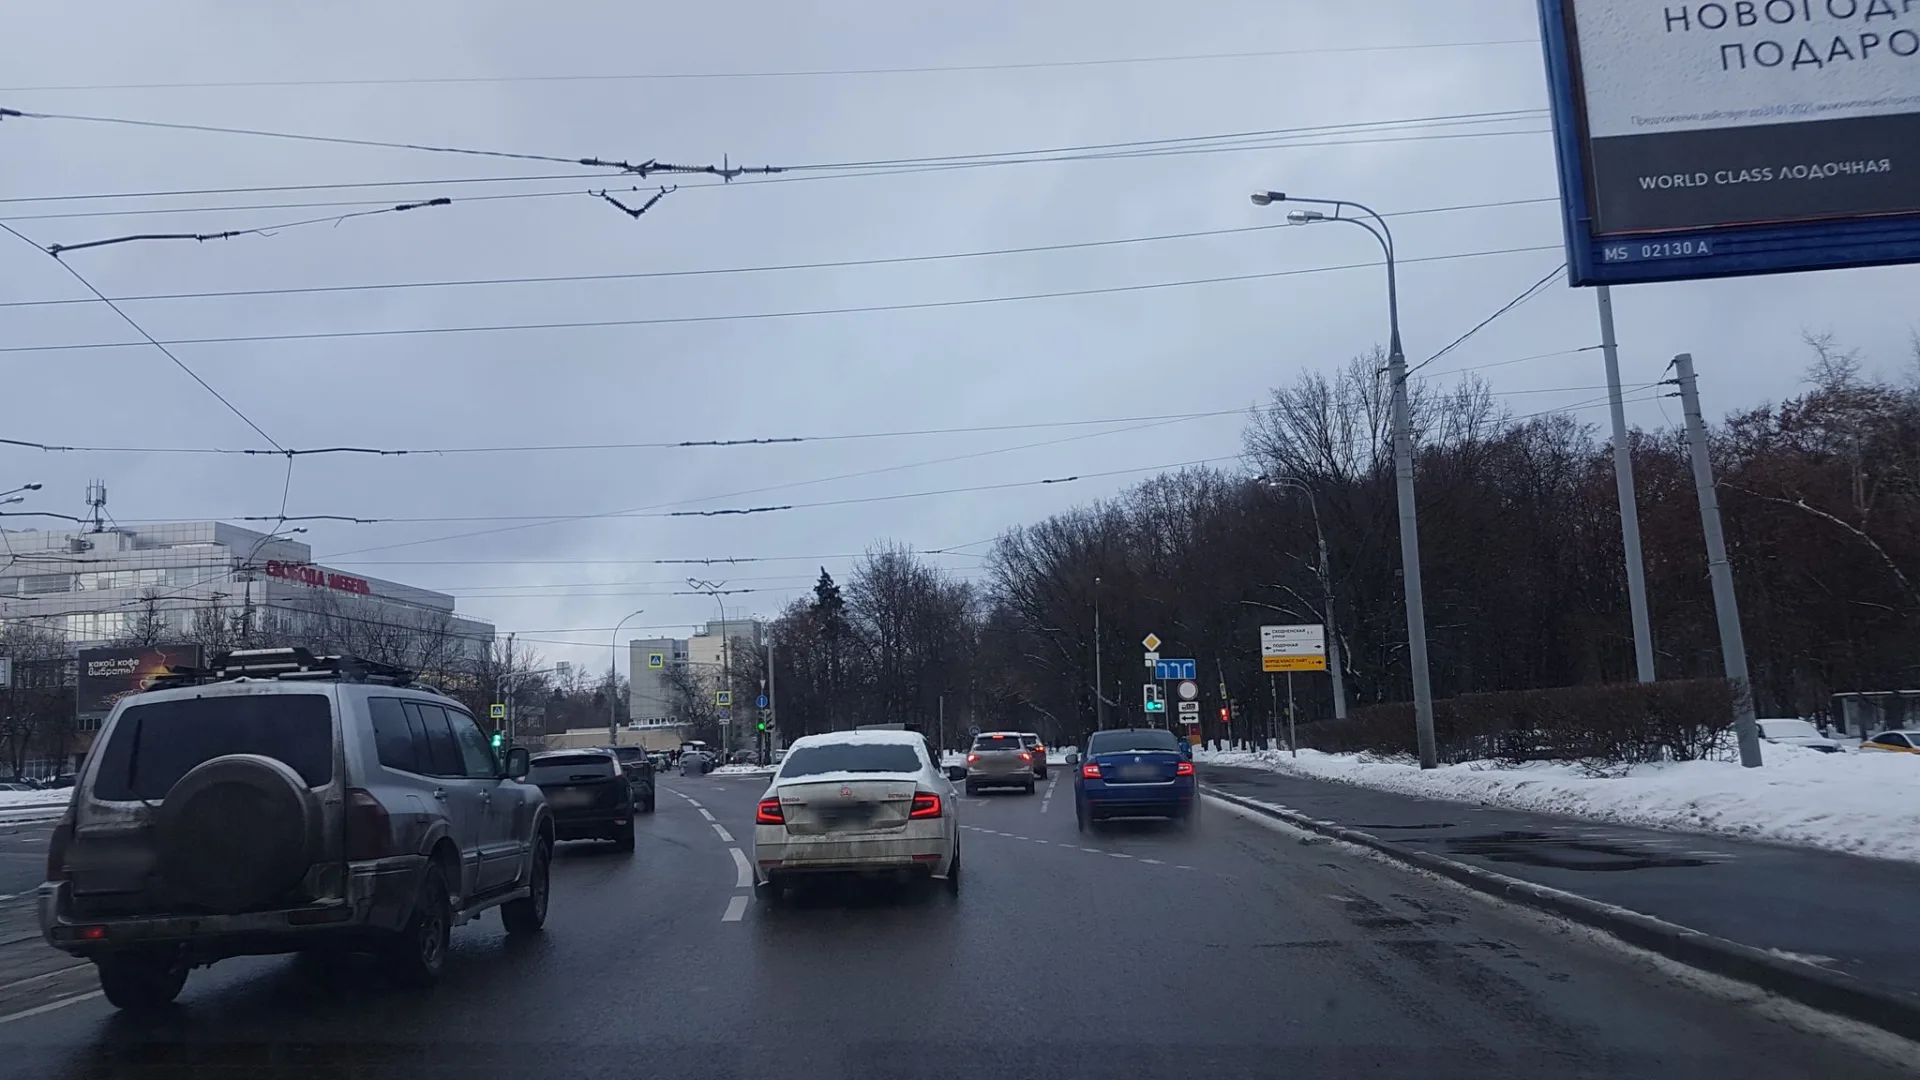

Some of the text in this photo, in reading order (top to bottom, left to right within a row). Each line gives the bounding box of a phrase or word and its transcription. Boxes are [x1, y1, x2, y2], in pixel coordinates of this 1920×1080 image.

[1720, 29, 1920, 71] ПОДАРО
[1639, 159, 1890, 189] WORLD CLASS ЛОДОЧНАЯ
[1604, 247, 1628, 260] MS
[1642, 242, 1692, 257] 02130
[88, 658, 140, 668] какой кофе
[88, 666, 135, 676] выбрать?
